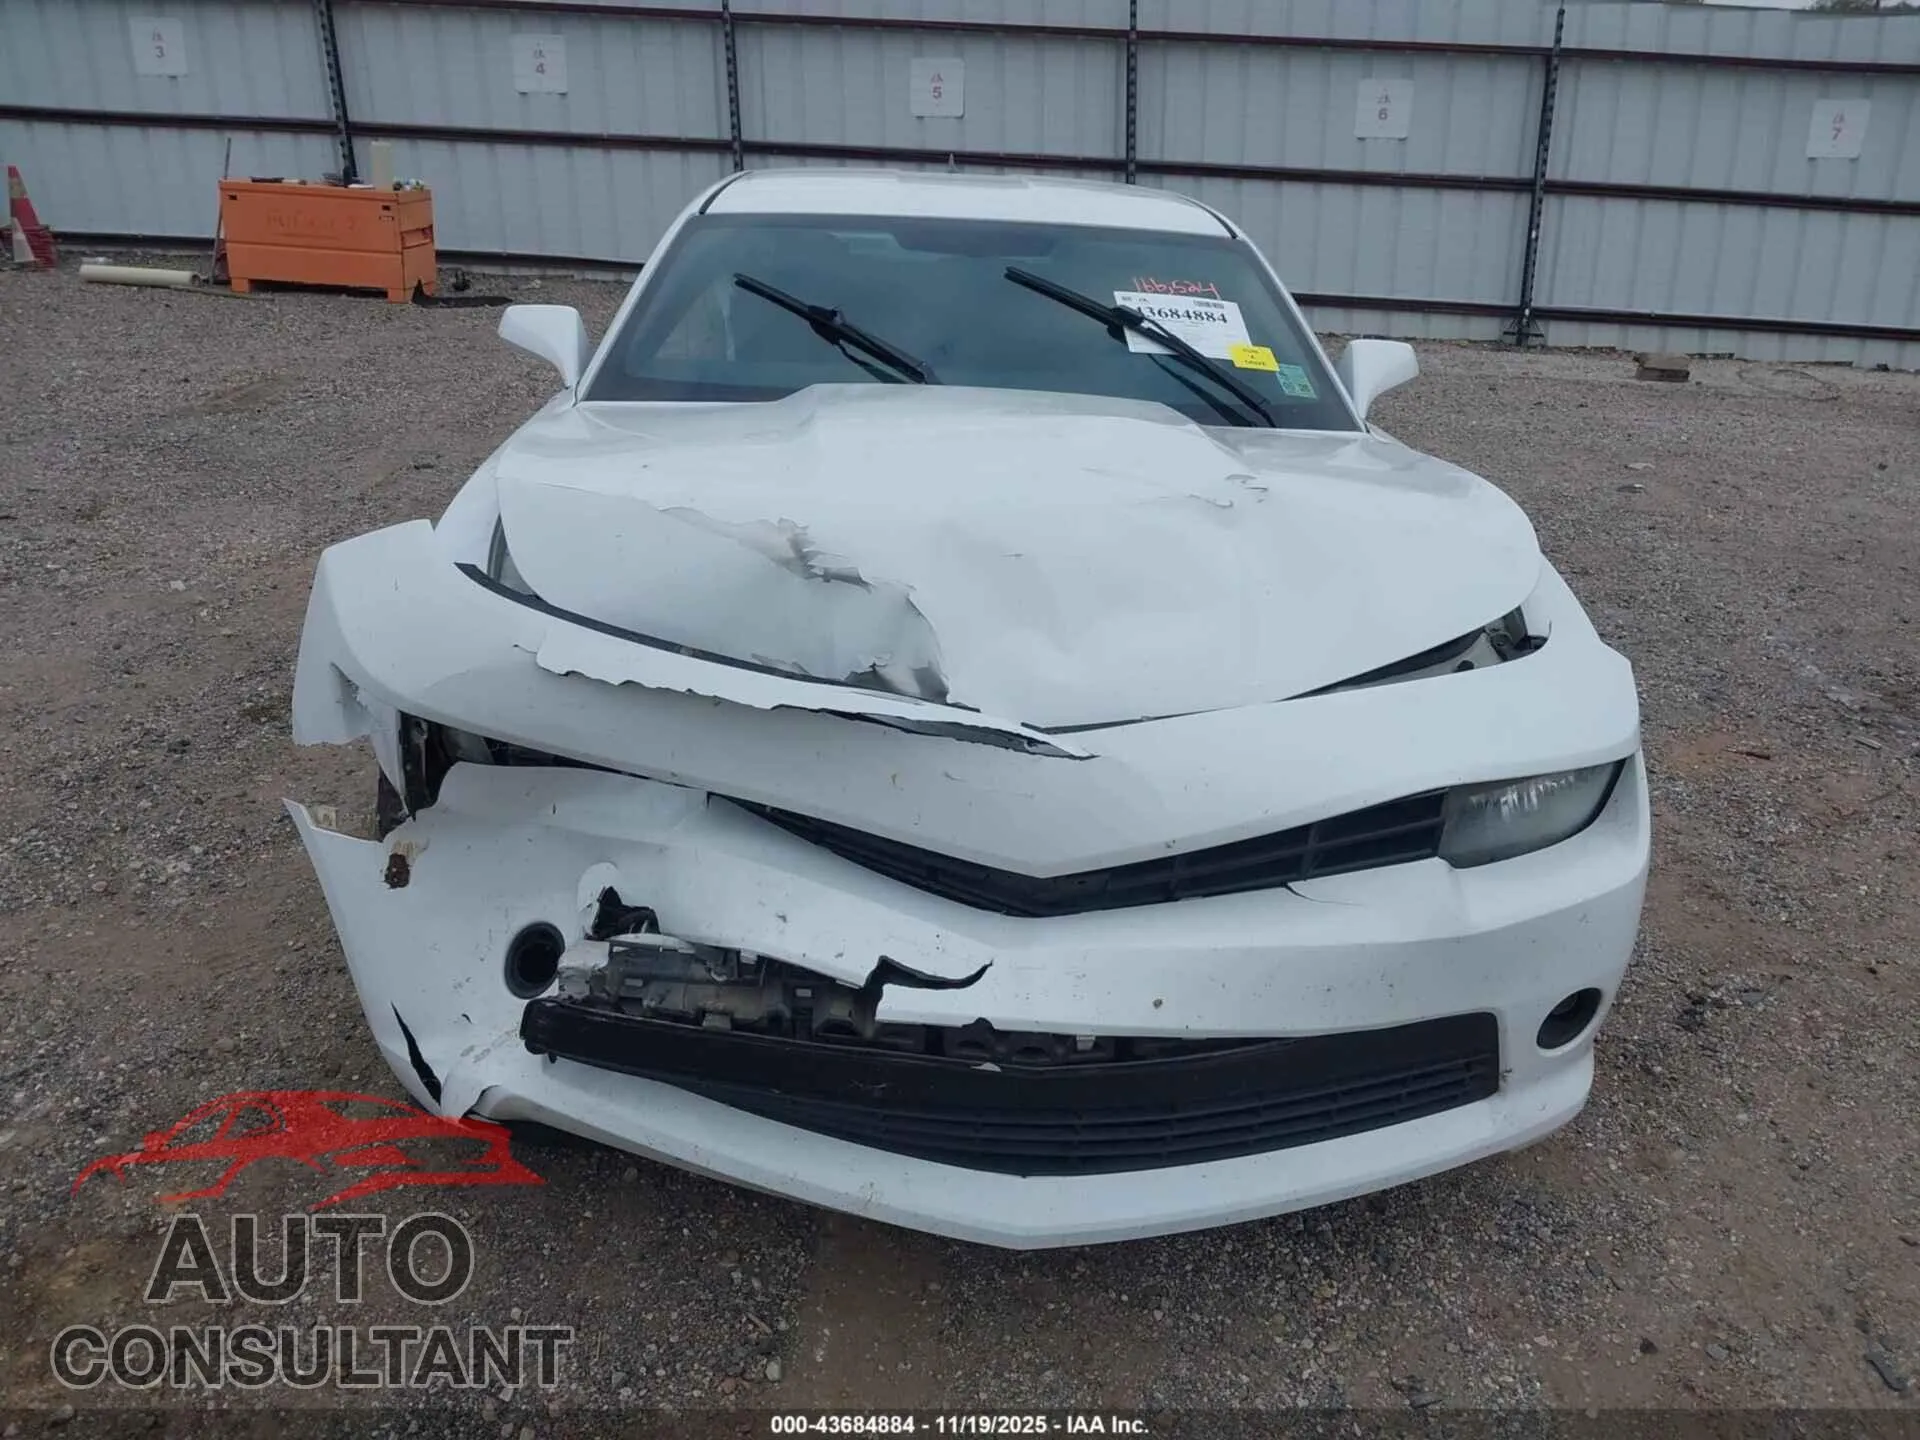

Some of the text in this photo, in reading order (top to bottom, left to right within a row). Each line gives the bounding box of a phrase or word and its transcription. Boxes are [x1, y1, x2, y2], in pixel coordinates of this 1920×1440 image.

[154, 45, 165, 59] 3
[534, 62, 546, 75] 4
[932, 86, 942, 100] 5
[1378, 107, 1388, 121] 6
[1831, 126, 1843, 141] 7
